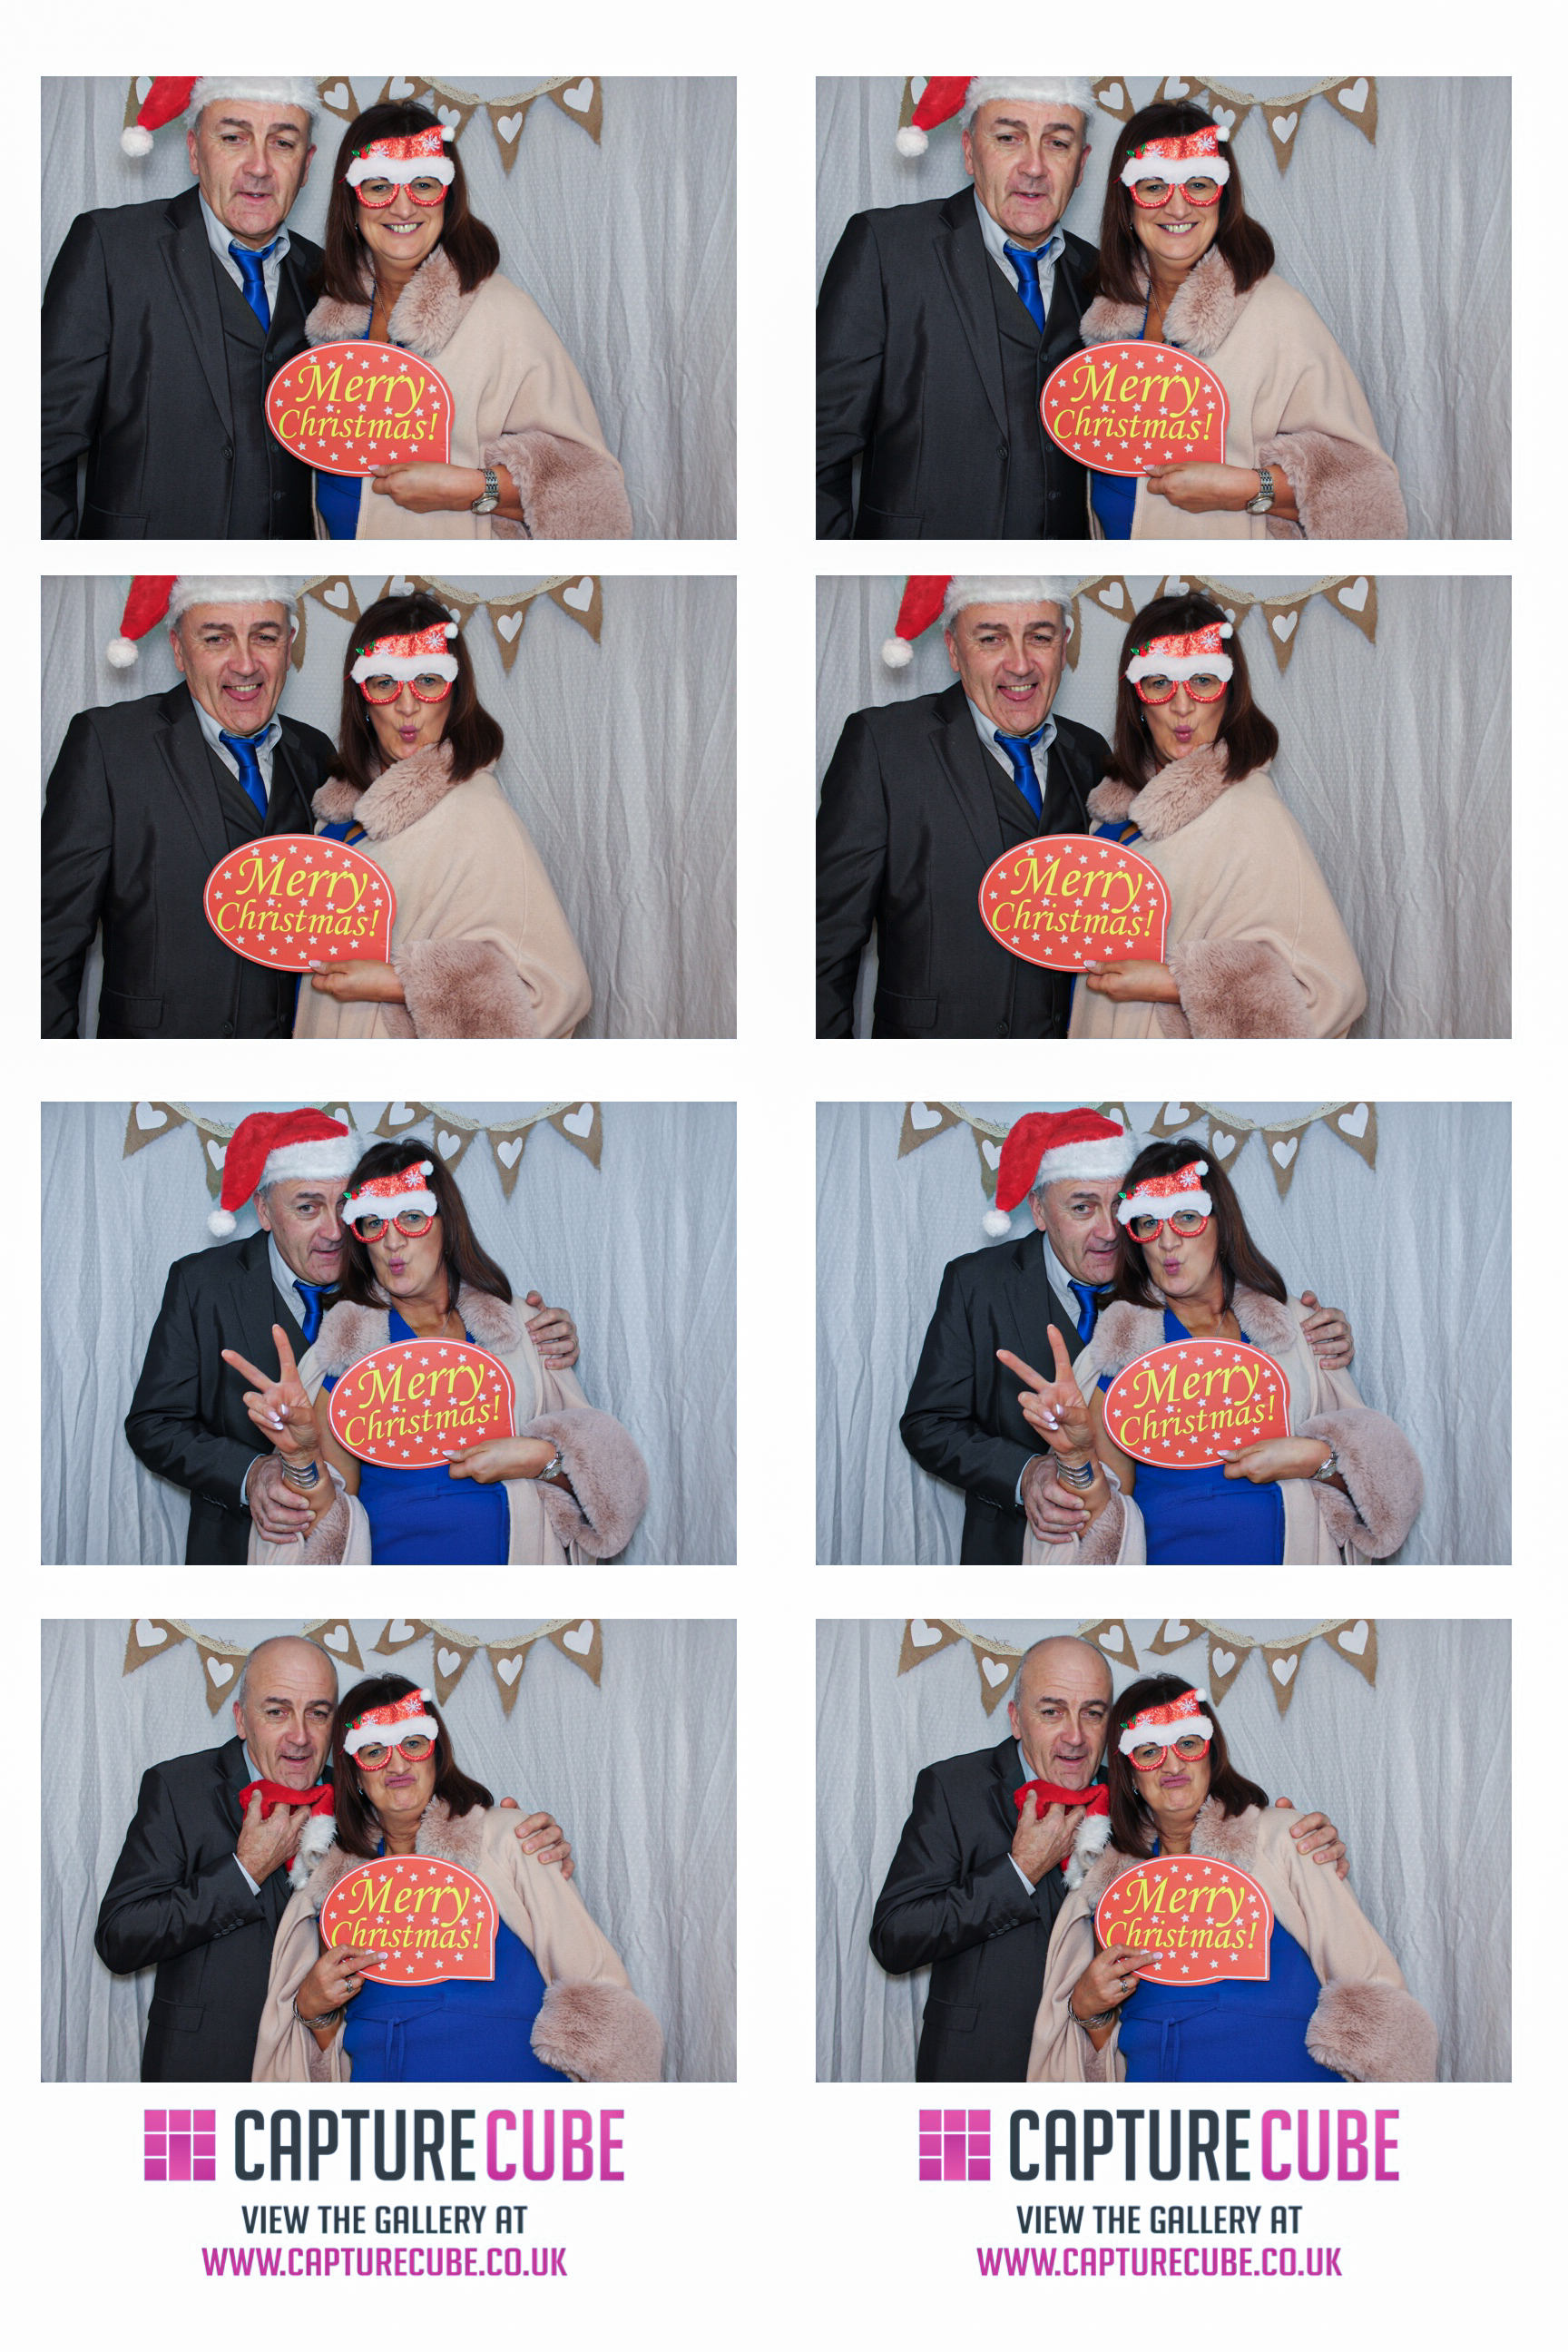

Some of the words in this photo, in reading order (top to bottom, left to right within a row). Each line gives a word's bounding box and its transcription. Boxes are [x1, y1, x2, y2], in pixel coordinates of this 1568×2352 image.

[295, 364, 426, 418] Merry
[1070, 364, 1200, 418] Merry
[278, 406, 438, 440] Christmas!
[1053, 406, 1213, 440] Christmas!
[235, 858, 369, 914] Merry
[1010, 858, 1144, 914] Merry
[217, 897, 380, 937] Christmas!
[992, 897, 1155, 937] Christmas!
[358, 1363, 485, 1409] Merry
[1133, 1363, 1260, 1409] Merry
[343, 1395, 500, 1446] Christmas!
[1118, 1395, 1275, 1446] Christmas!
[347, 1877, 471, 1928] Merry
[1122, 1877, 1246, 1928] Merry
